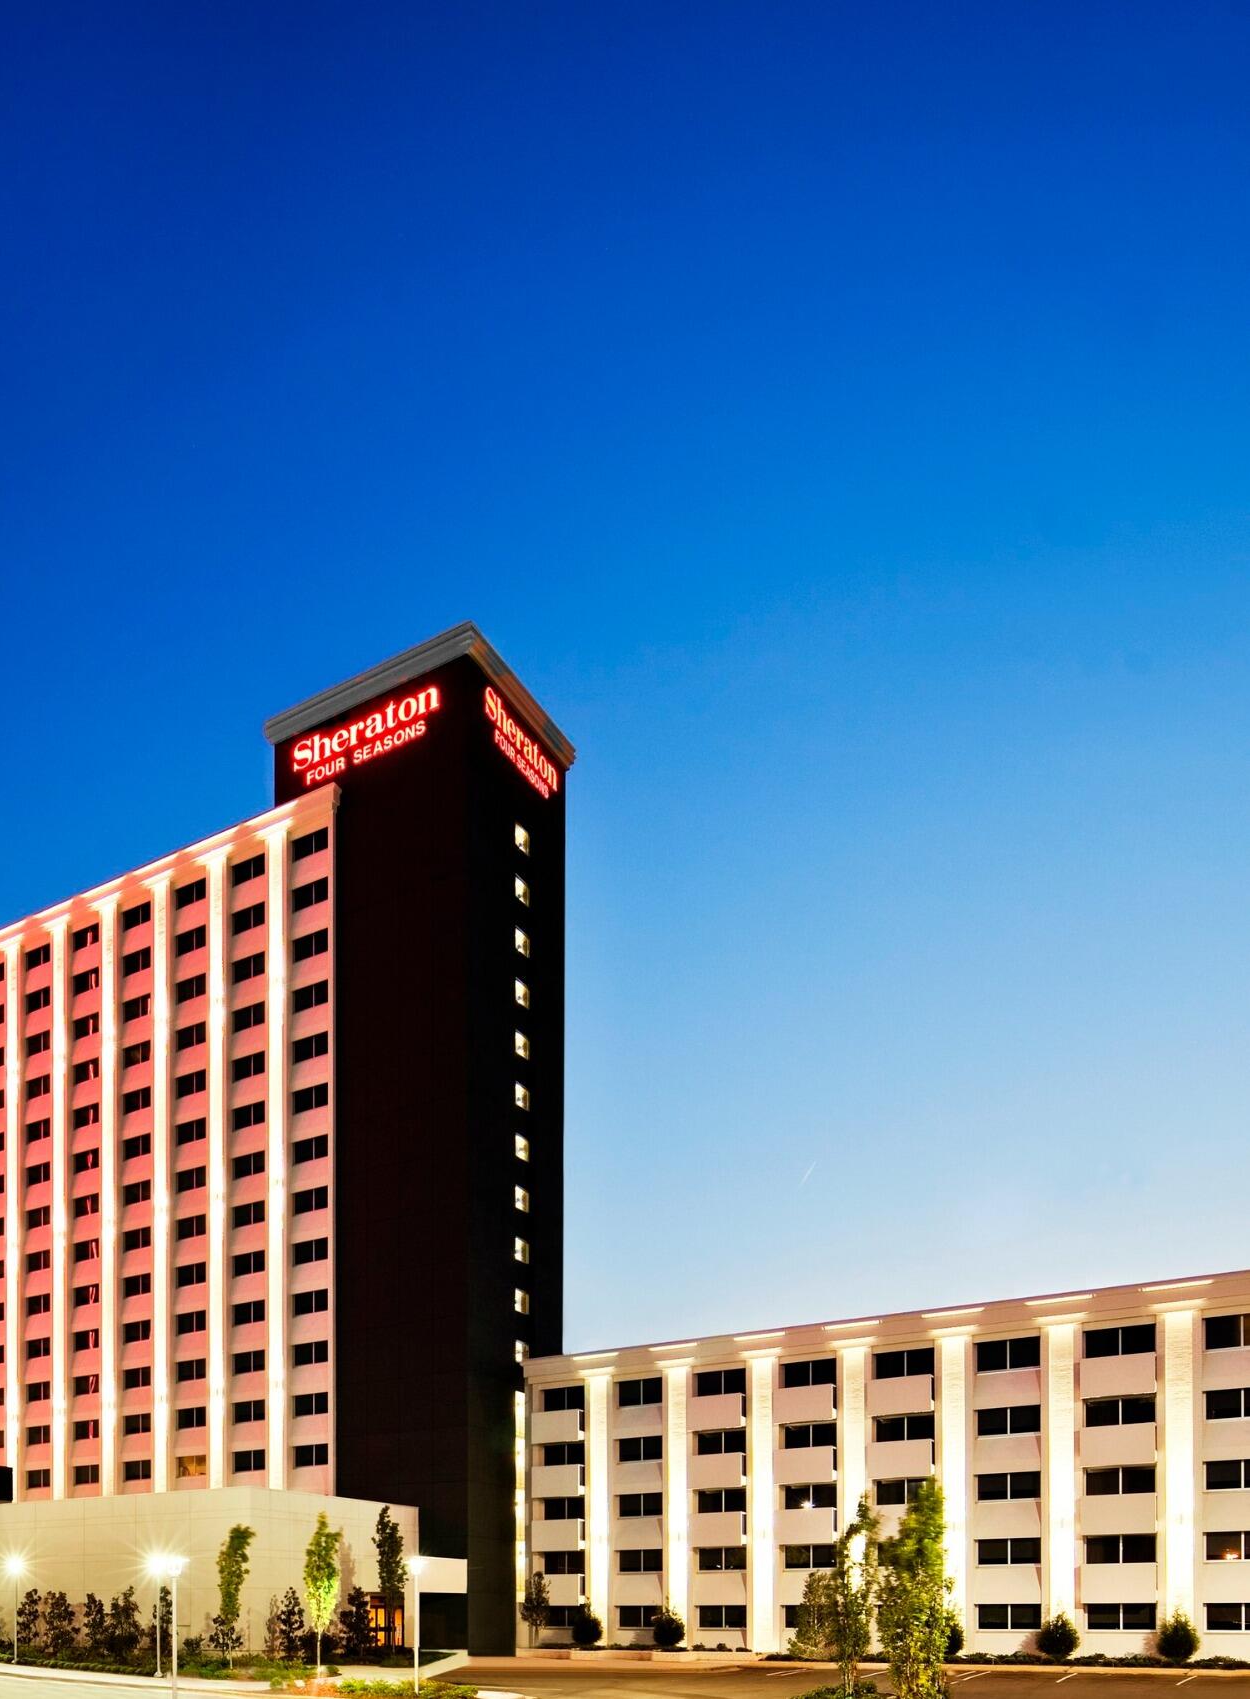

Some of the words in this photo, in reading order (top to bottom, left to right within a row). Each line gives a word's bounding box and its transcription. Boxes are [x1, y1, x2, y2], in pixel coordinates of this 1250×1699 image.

[293, 687, 439, 772] Sheraton
[306, 756, 345, 785] FOUR
[353, 720, 426, 764] SEASONS
[485, 687, 557, 792] Sheraton
[495, 729, 516, 763] FOUR
[516, 754, 549, 799] SEASONS
